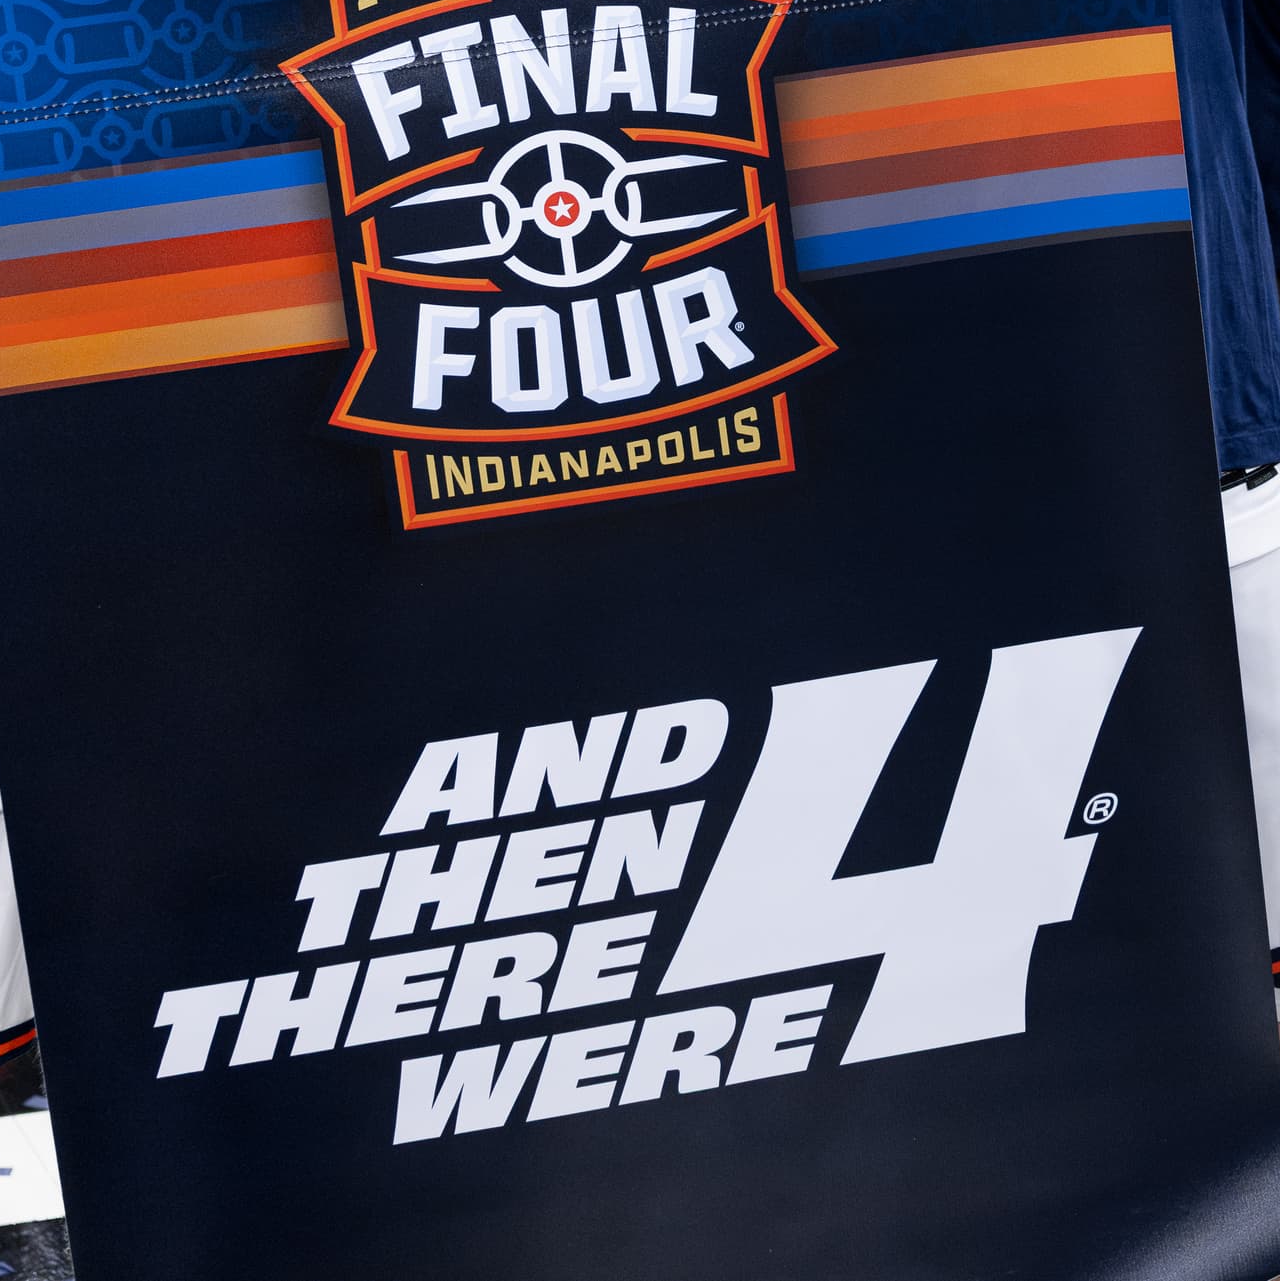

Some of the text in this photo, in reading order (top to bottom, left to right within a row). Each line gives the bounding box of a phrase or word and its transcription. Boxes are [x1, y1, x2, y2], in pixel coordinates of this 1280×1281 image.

[352, 5, 718, 161] FINAL
[412, 265, 755, 413] FOUR
[426, 407, 761, 499] INDIANAPOLIS
[379, 698, 729, 836] AND
[295, 799, 705, 952] THEN
[152, 911, 657, 1079] THERE
[392, 984, 833, 1146] WERE
